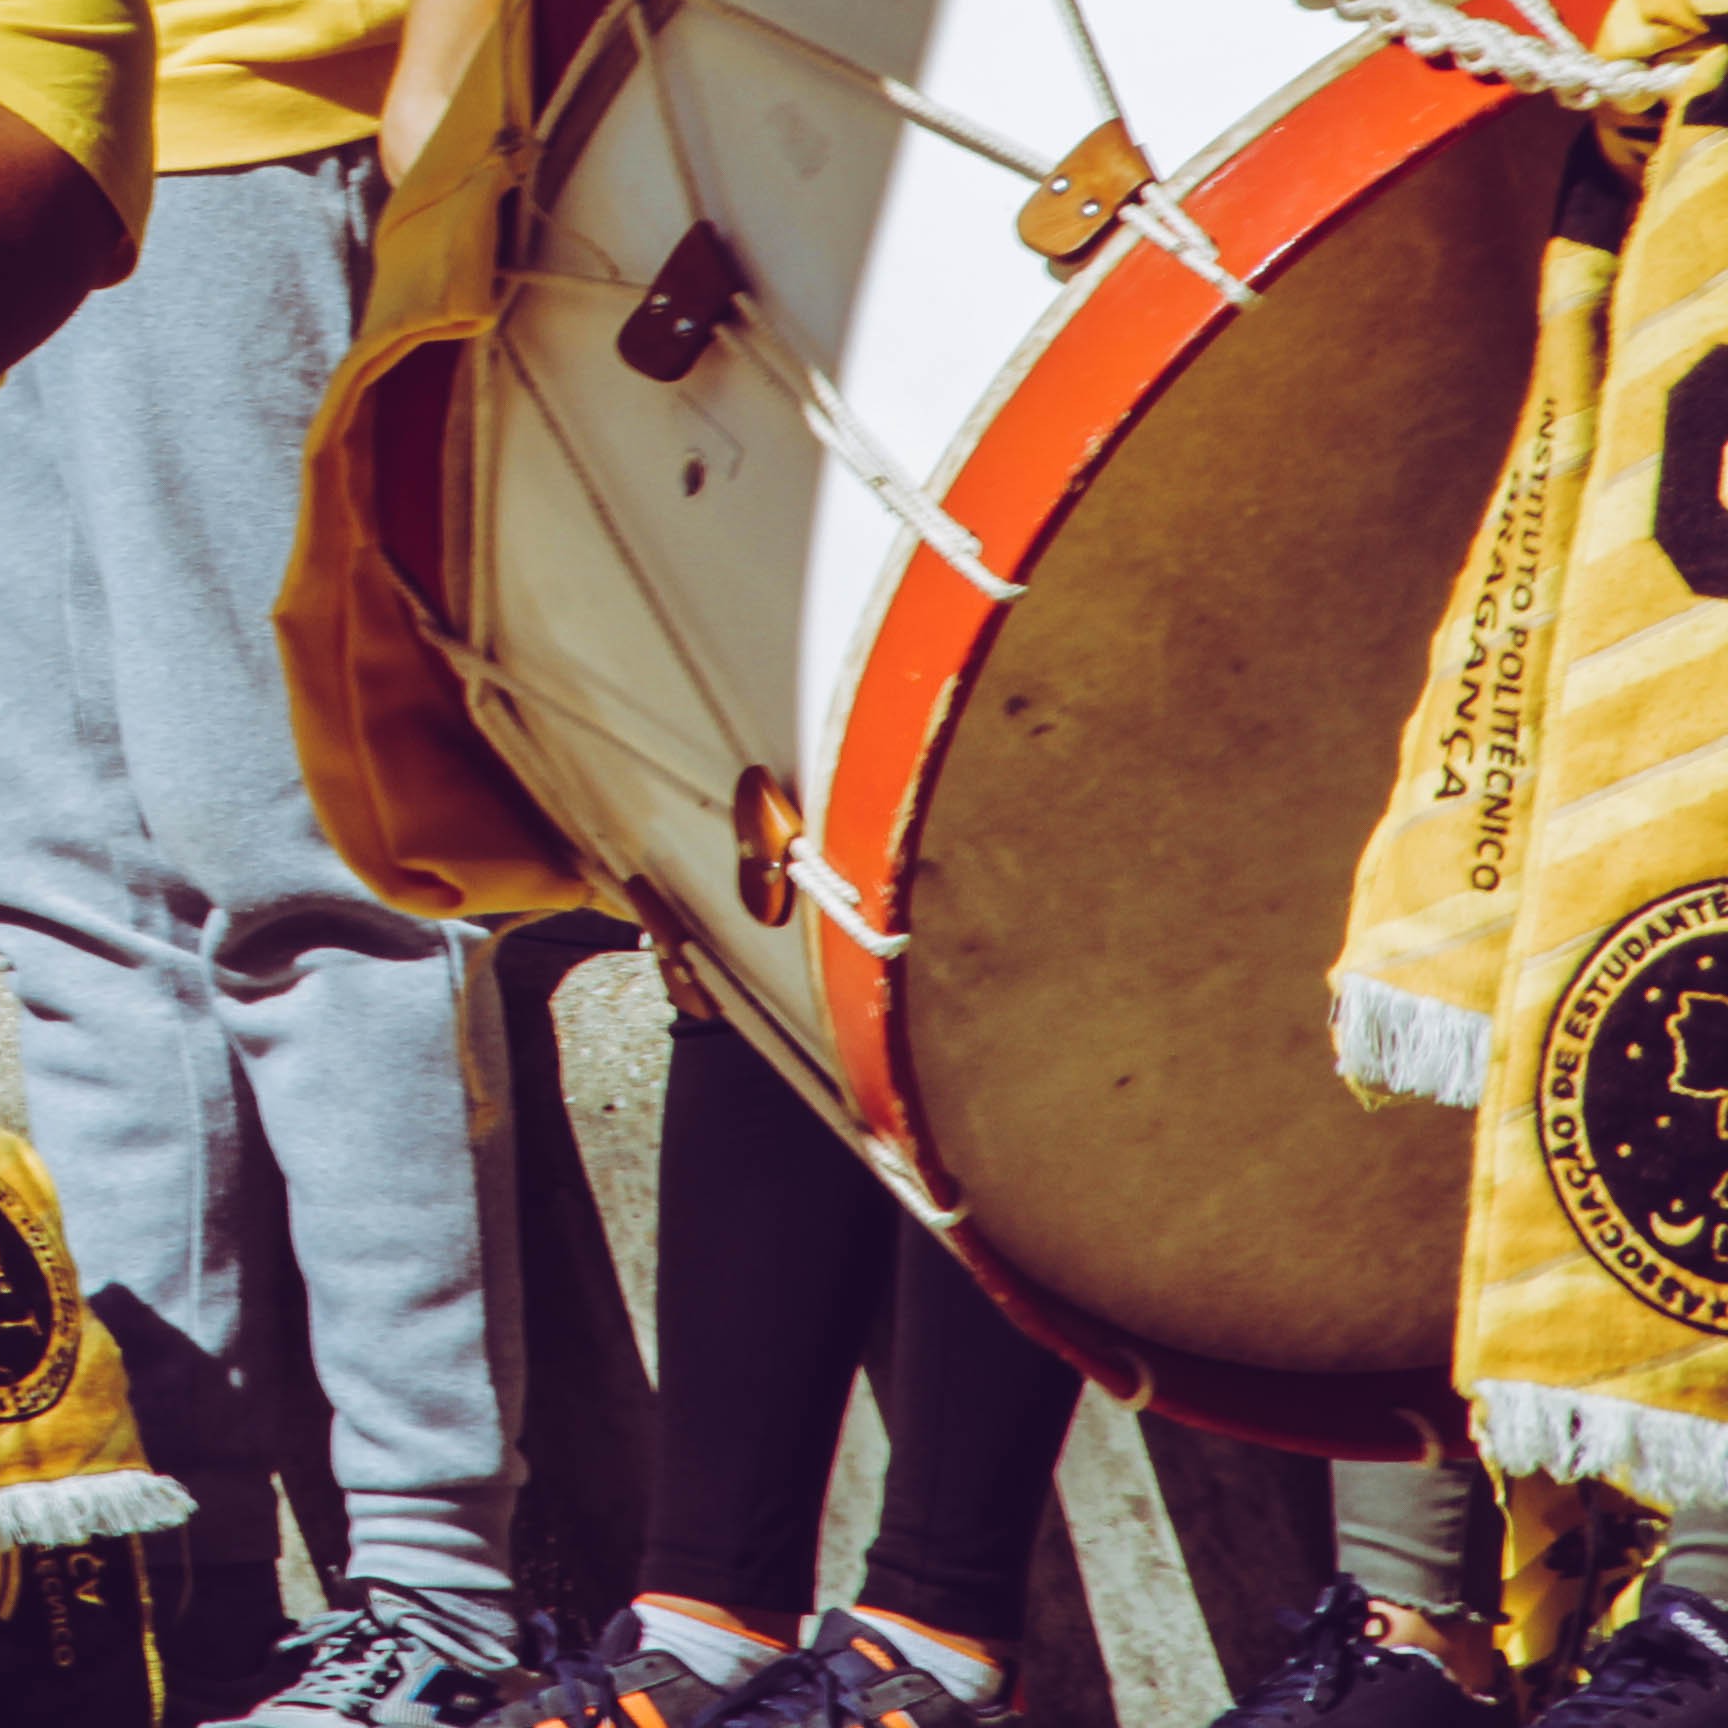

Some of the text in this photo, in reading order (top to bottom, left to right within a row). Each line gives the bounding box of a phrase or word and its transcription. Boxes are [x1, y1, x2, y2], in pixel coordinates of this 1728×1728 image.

[1511, 397, 1557, 611] INSTITUTO
[1470, 624, 1528, 894] POLITÉCNICO
[1551, 1048, 1578, 1100] DE
